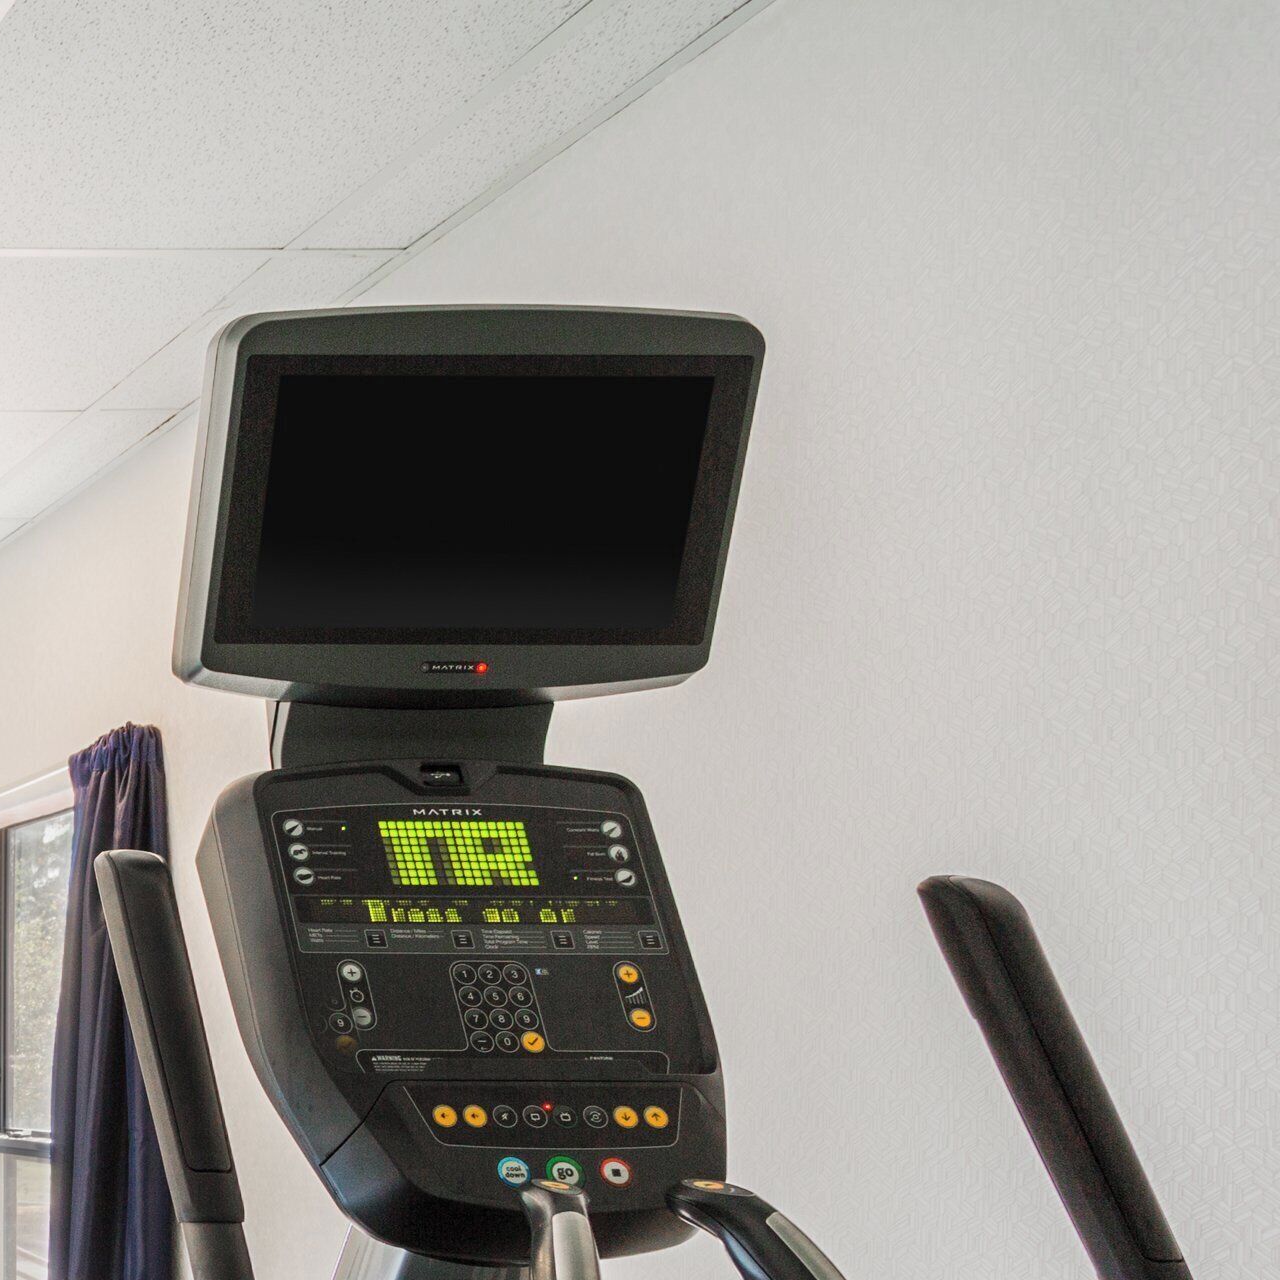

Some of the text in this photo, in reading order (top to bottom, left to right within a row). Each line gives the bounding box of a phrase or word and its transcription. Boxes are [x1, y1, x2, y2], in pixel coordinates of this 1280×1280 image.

[412, 808, 482, 816] MATRIX
[462, 970, 518, 978] 1 2 3
[467, 992, 524, 1001] 4 5 6
[472, 1014, 530, 1023] 7 8 9
[503, 1037, 511, 1046] 0
[557, 1168, 574, 1180] go
